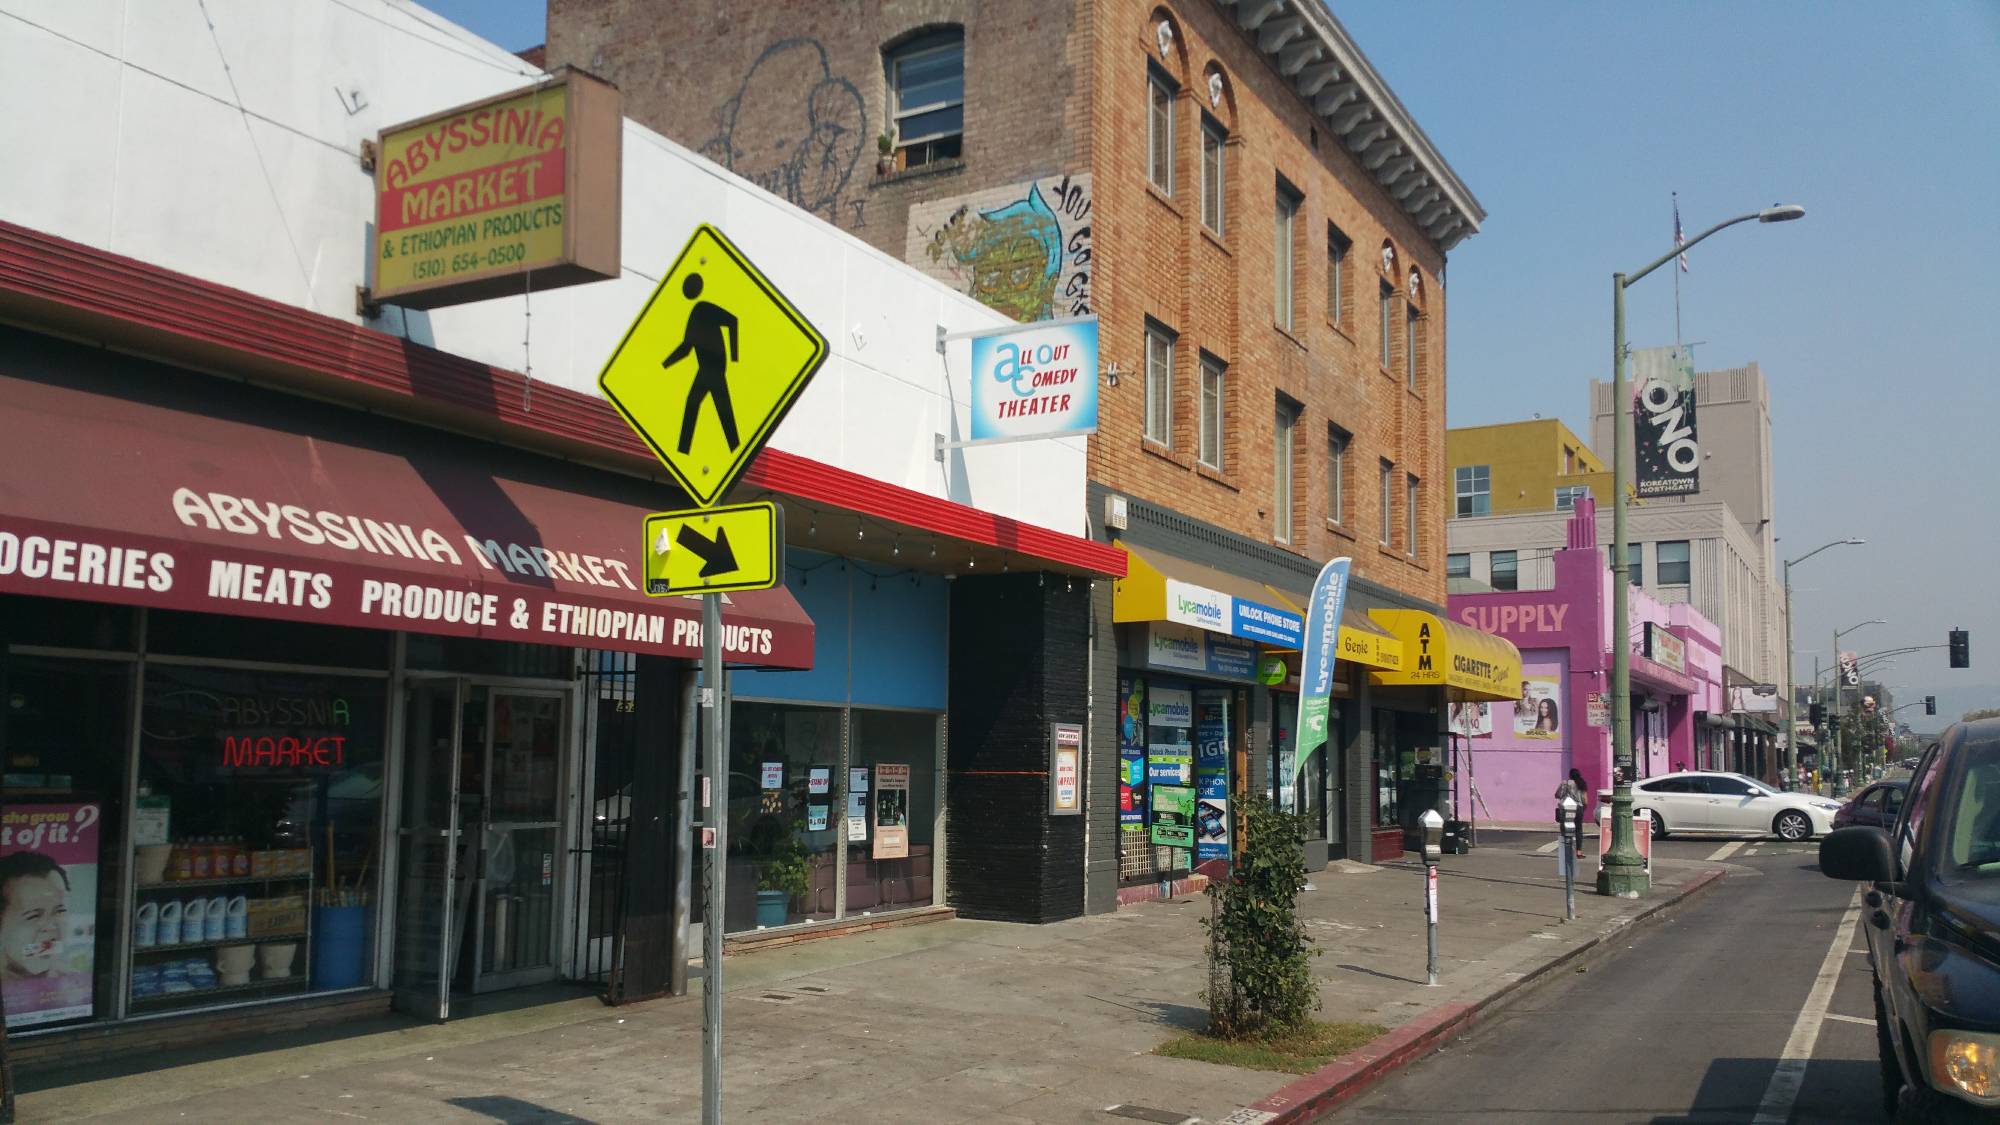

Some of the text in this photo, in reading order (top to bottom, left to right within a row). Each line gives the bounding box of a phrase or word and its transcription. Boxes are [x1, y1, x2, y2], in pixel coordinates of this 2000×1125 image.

[386, 108, 564, 191] ABYSSINIA
[401, 161, 542, 224] MARKET
[383, 204, 562, 259] & ETHIOPIAN PRODUCTS
[413, 242, 526, 279] (510) 654-0500
[998, 394, 1071, 419] THEATER
[1640, 477, 1694, 487] KOREATOWN
[1640, 484, 1694, 493] NORTHGATE
[172, 487, 638, 591] ABYSSINIA MARKET
[208, 560, 333, 609] MEATS
[361, 579, 498, 626] PRODUCE
[510, 597, 529, 630] &
[542, 602, 664, 644] ETHIOPIAN
[1178, 594, 1222, 620] Lycamobile
[1238, 604, 1300, 632] UNLOCK PHONE STORE
[1315, 572, 1340, 693] Lycamobile
[1461, 604, 1569, 634] SUPPLY
[1154, 631, 1199, 654] Lycamobile
[1345, 636, 1368, 655] Genie
[1418, 622, 1431, 671] ATM
[1454, 654, 1491, 679] CIGARETTE
[223, 736, 347, 768] MARKET
[1149, 766, 1160, 777] Our
[16, 823, 47, 849] of
